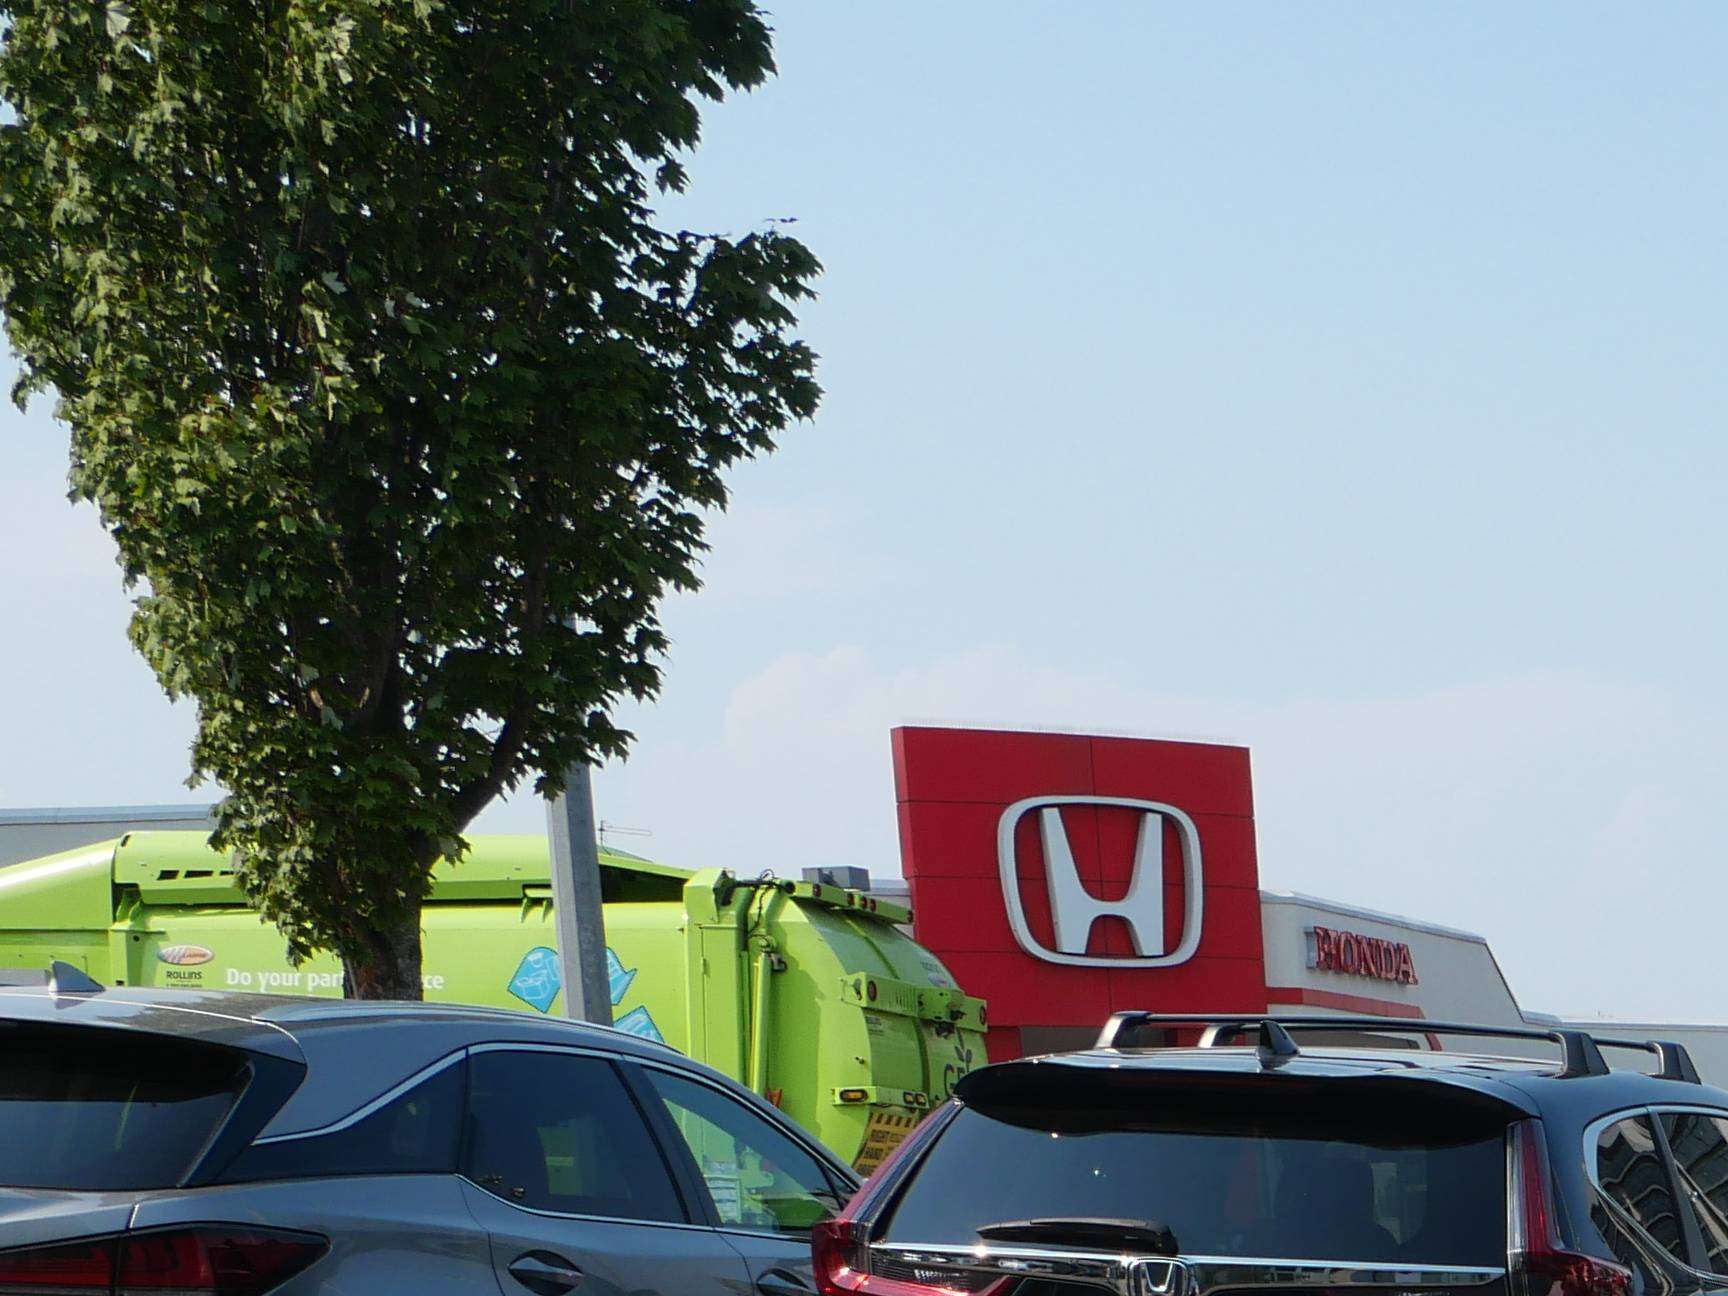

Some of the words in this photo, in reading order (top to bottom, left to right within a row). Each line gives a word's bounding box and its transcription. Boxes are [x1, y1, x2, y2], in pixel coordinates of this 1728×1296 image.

[1304, 925, 1419, 986] HONDA
[225, 967, 251, 986] Do
[256, 969, 302, 992] your
[307, 972, 344, 991] par
